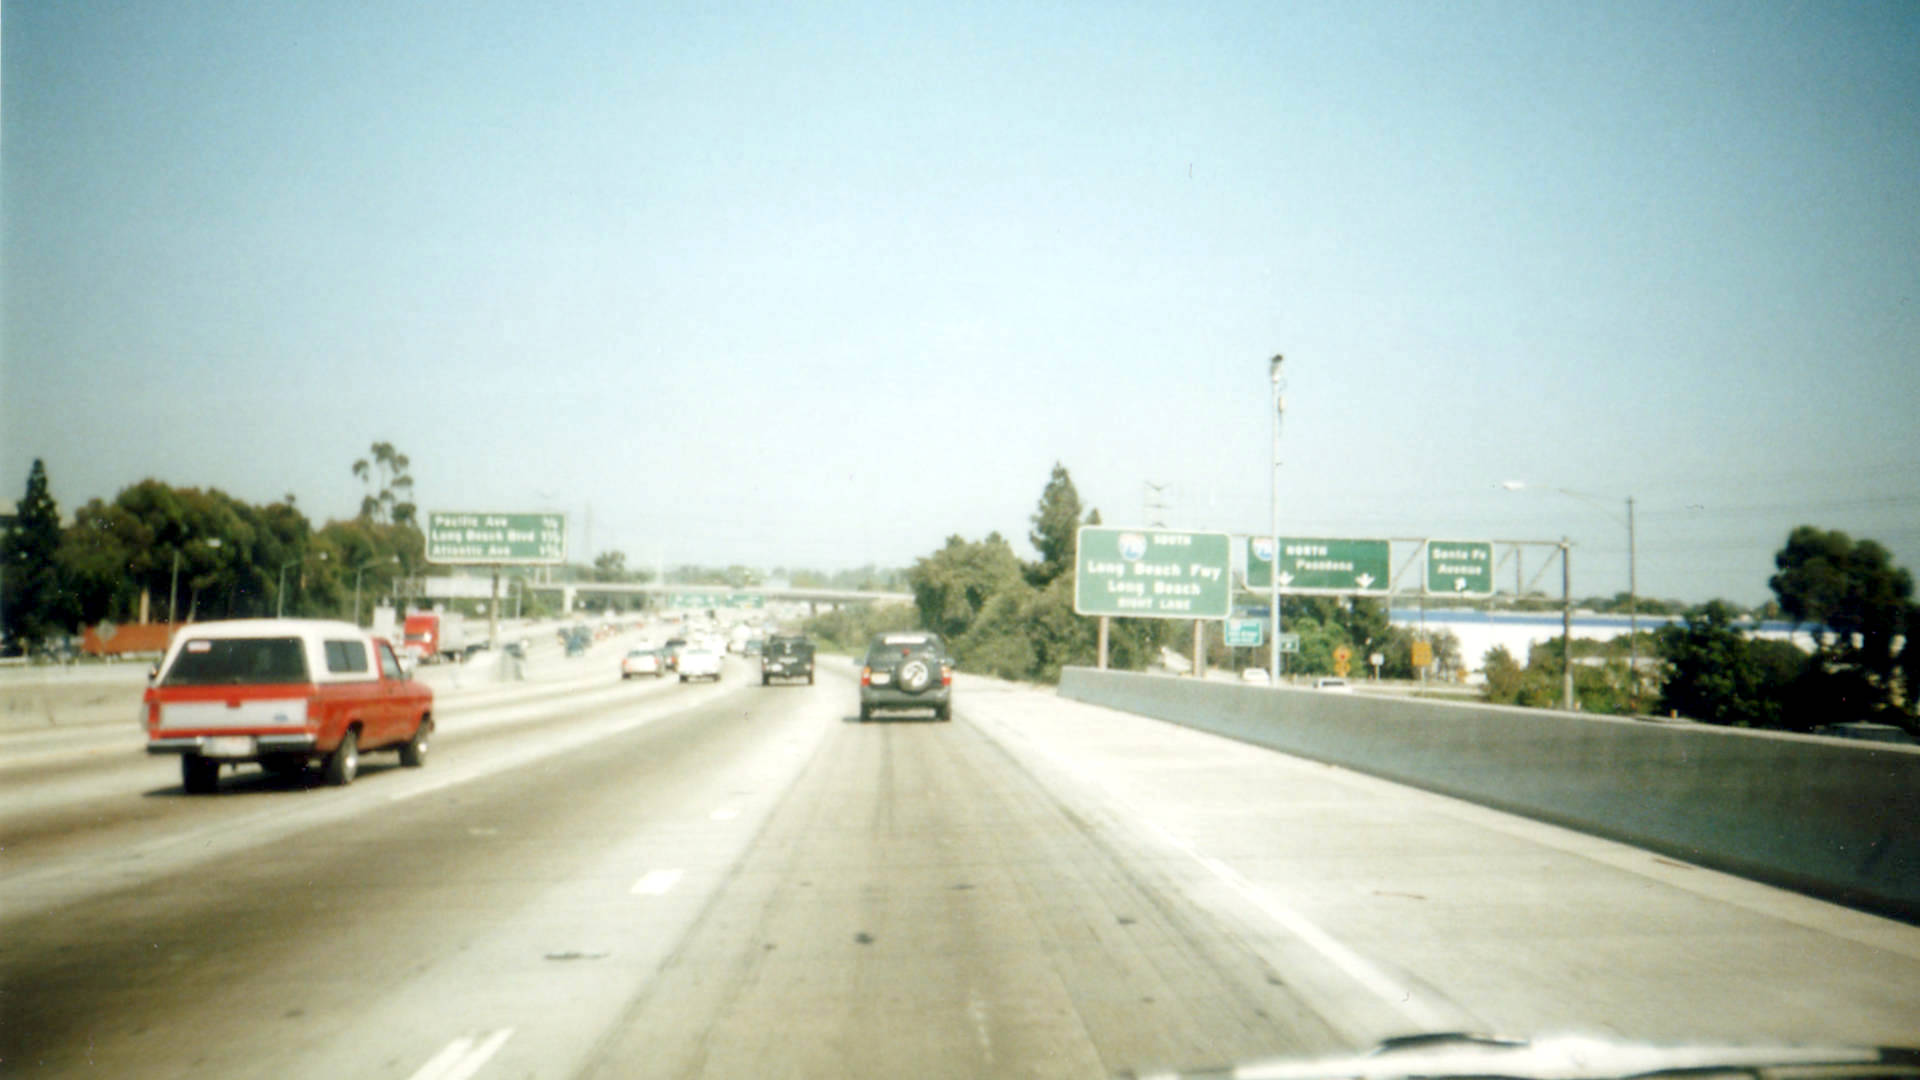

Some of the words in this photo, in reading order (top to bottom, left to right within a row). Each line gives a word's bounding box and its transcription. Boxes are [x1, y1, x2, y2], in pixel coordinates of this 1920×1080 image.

[431, 530, 462, 543] Long
[465, 529, 503, 542] Beach
[1153, 535, 1192, 545] SOUTH
[1286, 545, 1328, 556] NORTH
[1432, 548, 1468, 560] Santa
[1472, 549, 1487, 560] Fe
[1087, 560, 1125, 577] Long
[1134, 562, 1181, 576] Beach
[1190, 564, 1222, 582] Fwy
[1296, 559, 1354, 571] Pasadena
[1437, 564, 1482, 575] Avenue
[1107, 580, 1145, 596] Long
[1154, 581, 1201, 595] Beach
[1117, 598, 1153, 609] RIGHT
[1159, 599, 1191, 610] LANE
